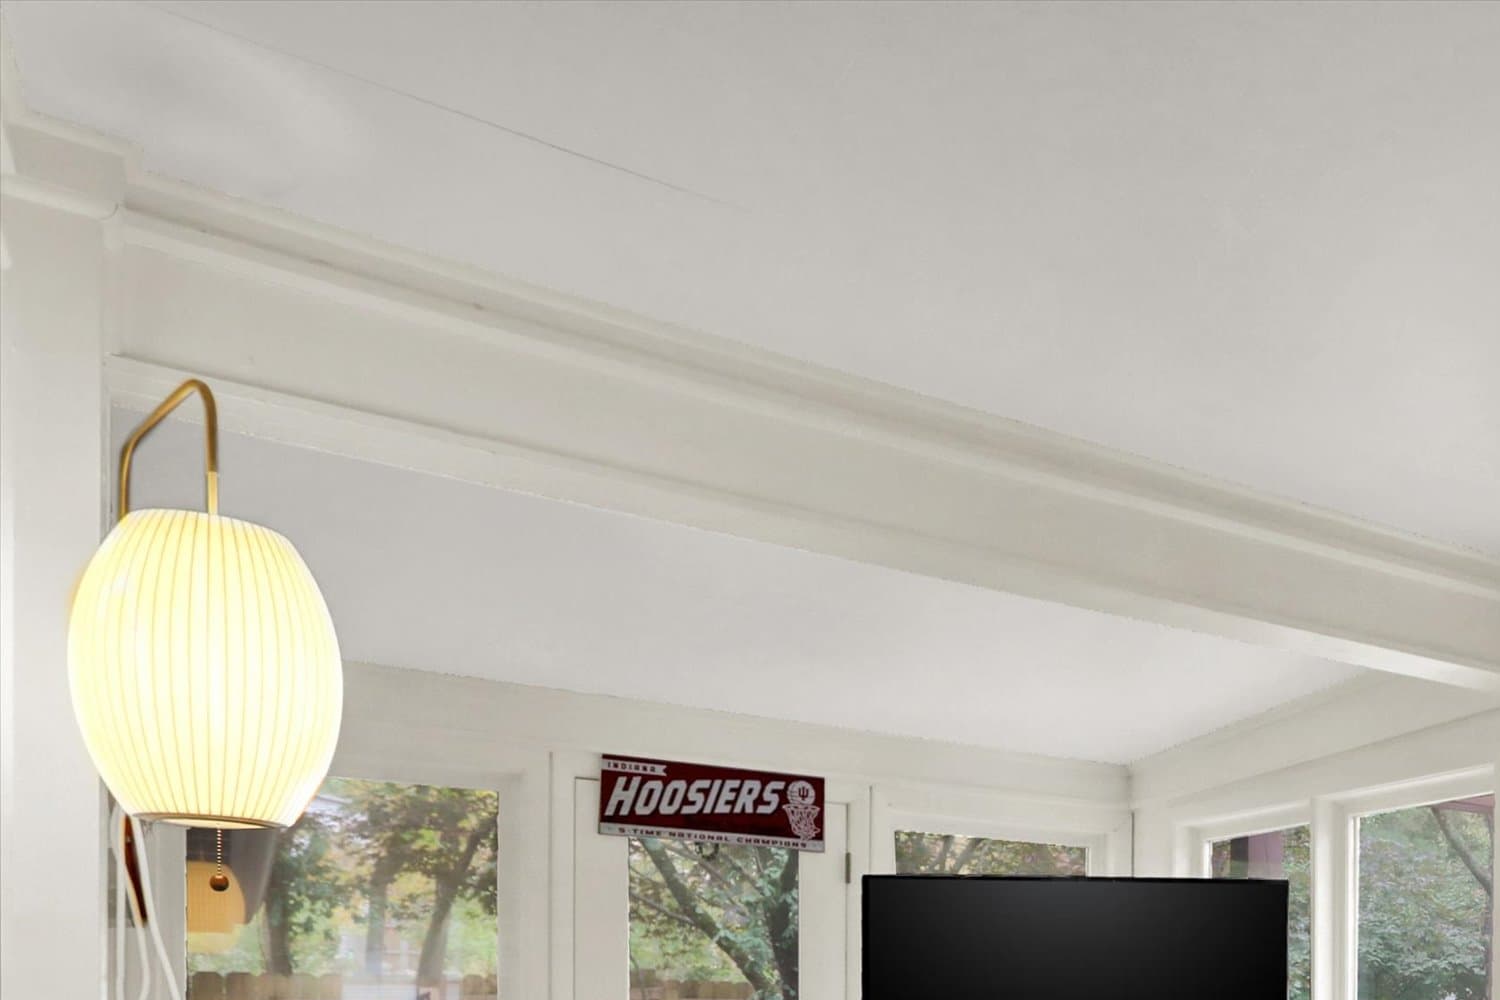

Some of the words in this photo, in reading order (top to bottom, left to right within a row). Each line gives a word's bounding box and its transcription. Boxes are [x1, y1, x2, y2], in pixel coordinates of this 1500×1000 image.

[607, 761, 656, 773] INDIANA
[604, 776, 787, 817] HOOSIERS
[668, 831, 730, 842] NATIONAL
[736, 837, 807, 848] CHAMPIONS
